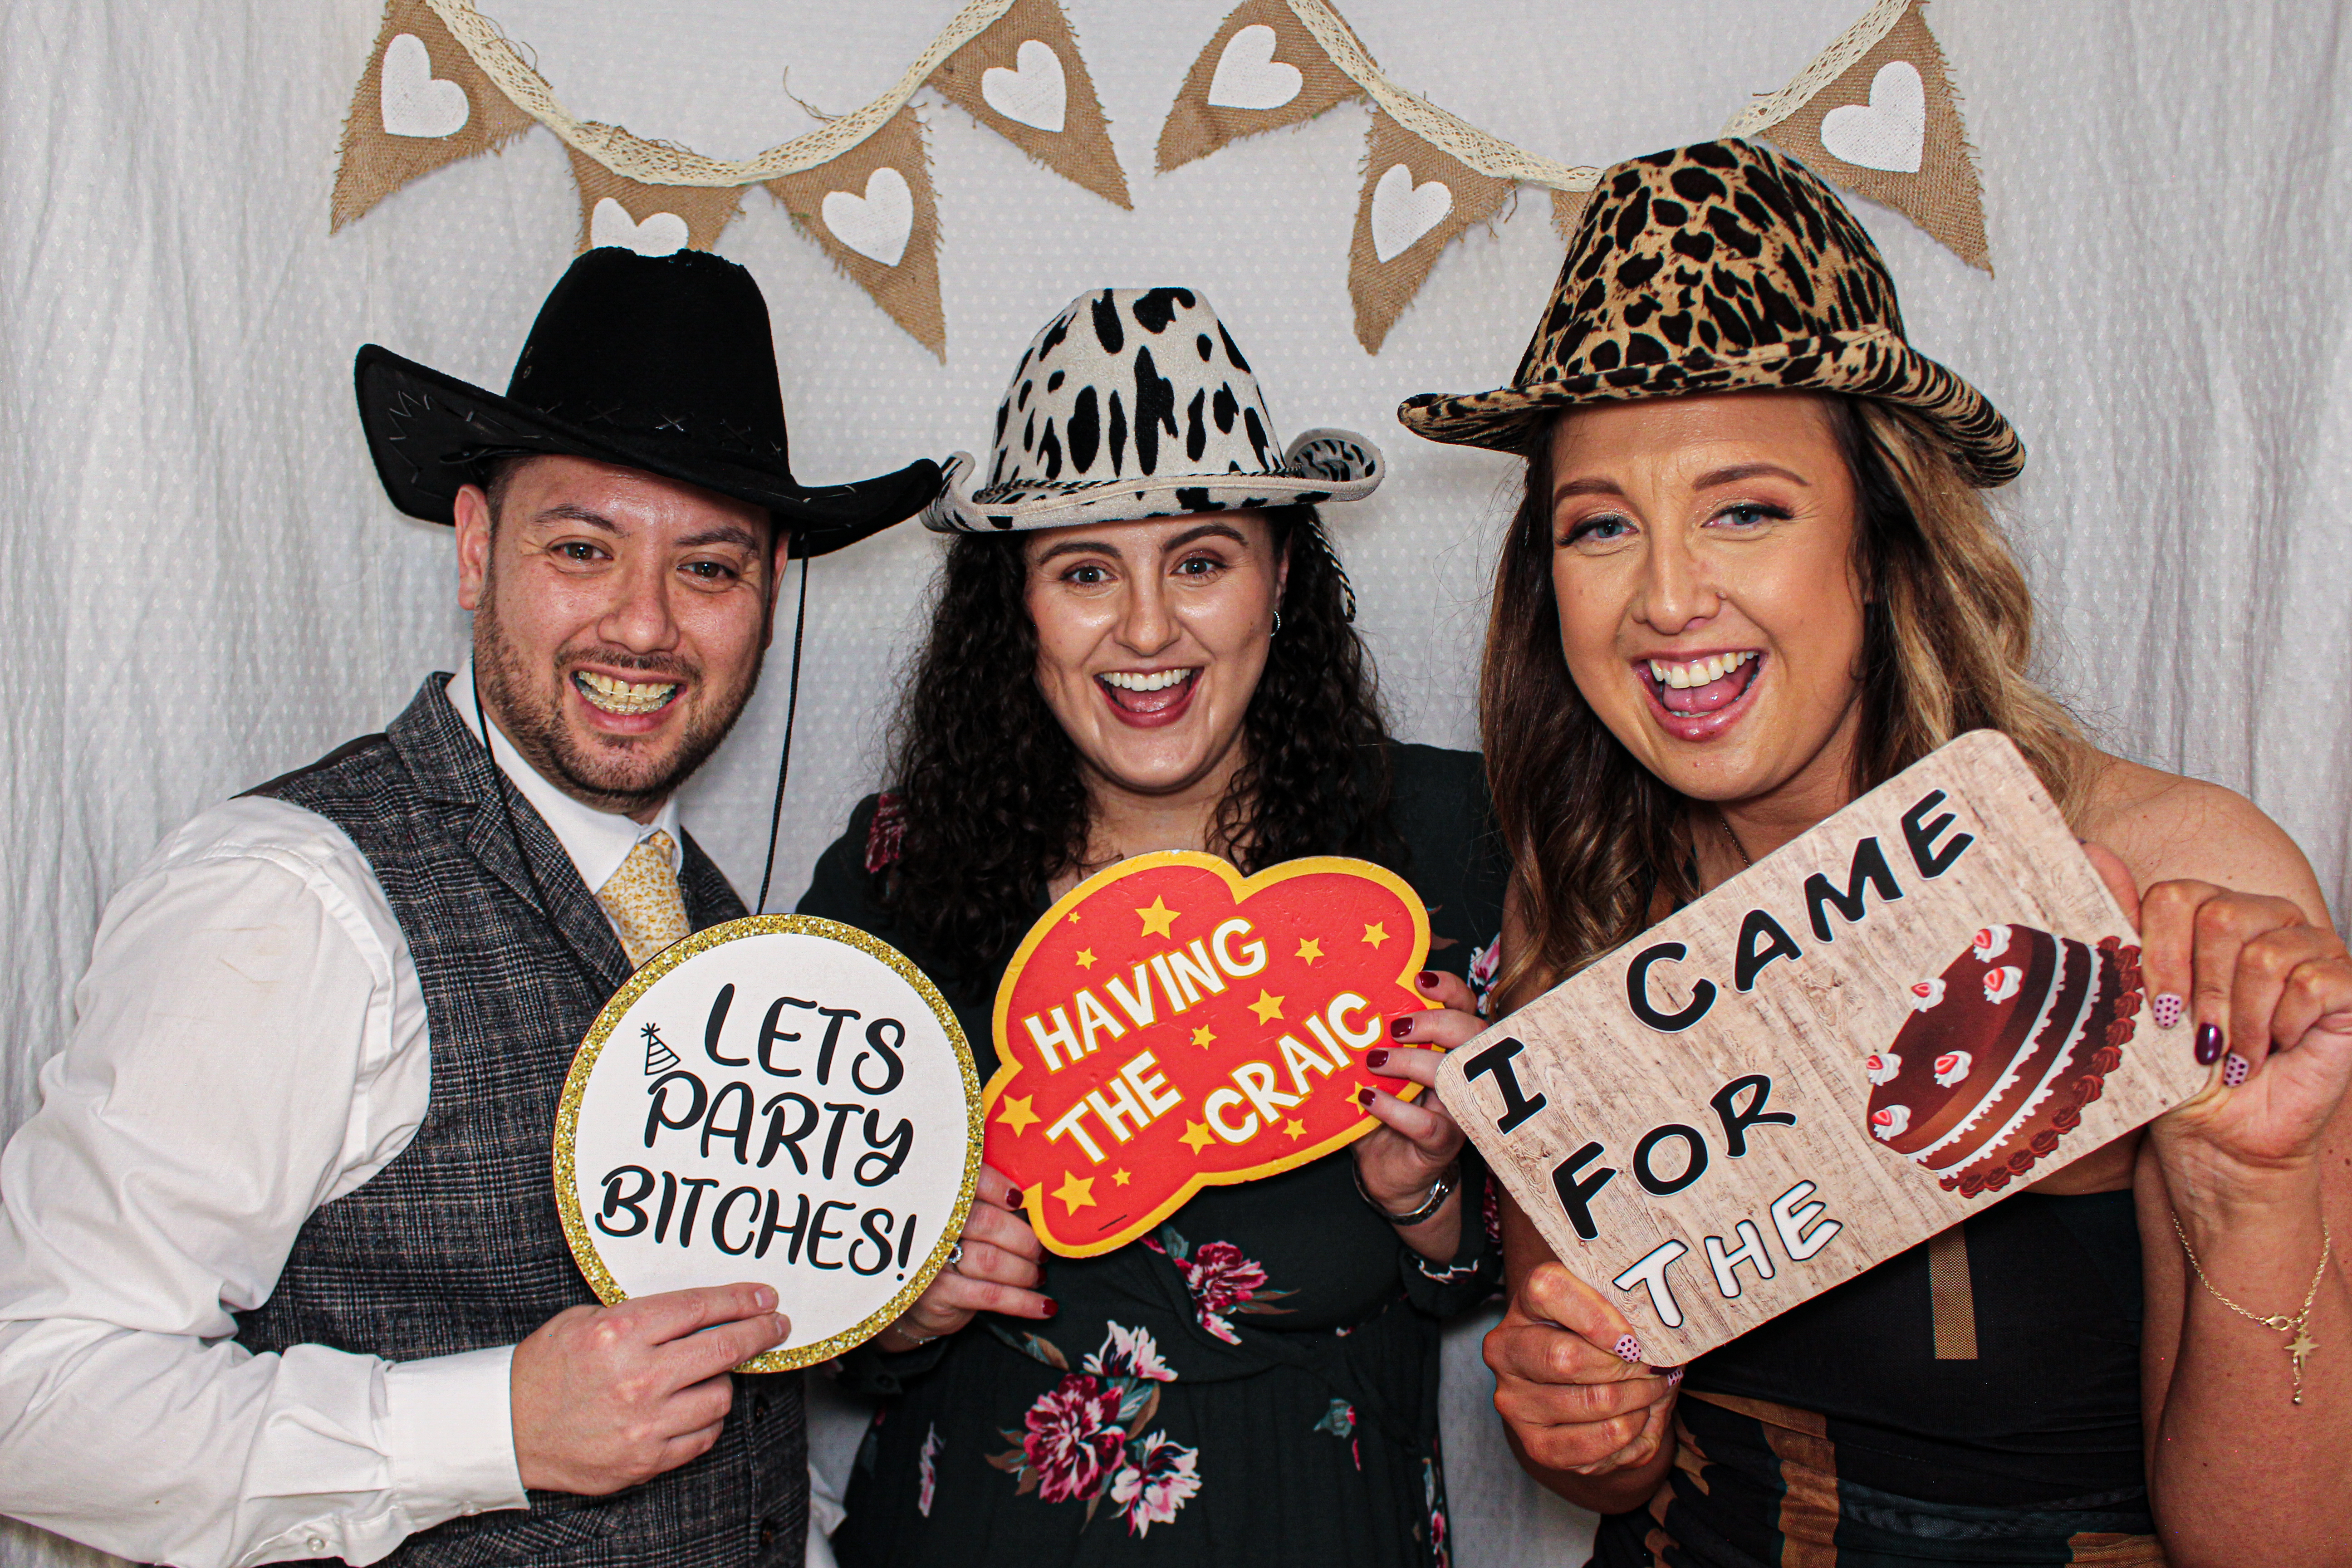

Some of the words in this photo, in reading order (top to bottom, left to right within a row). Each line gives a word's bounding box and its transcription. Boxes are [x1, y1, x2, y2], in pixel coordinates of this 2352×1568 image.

[1022, 916, 1269, 1074] HAVING
[1464, 1037, 1546, 1134] I
[1626, 788, 1974, 1034] CAME
[704, 983, 905, 1095] LETS
[1043, 1049, 1185, 1165] THE
[1202, 991, 1383, 1145] CRAIC
[644, 1070, 914, 1187] PARTY
[1552, 1073, 1797, 1240] FOR
[595, 1165, 916, 1281] BITCHES!
[1613, 1179, 1844, 1328] THE
